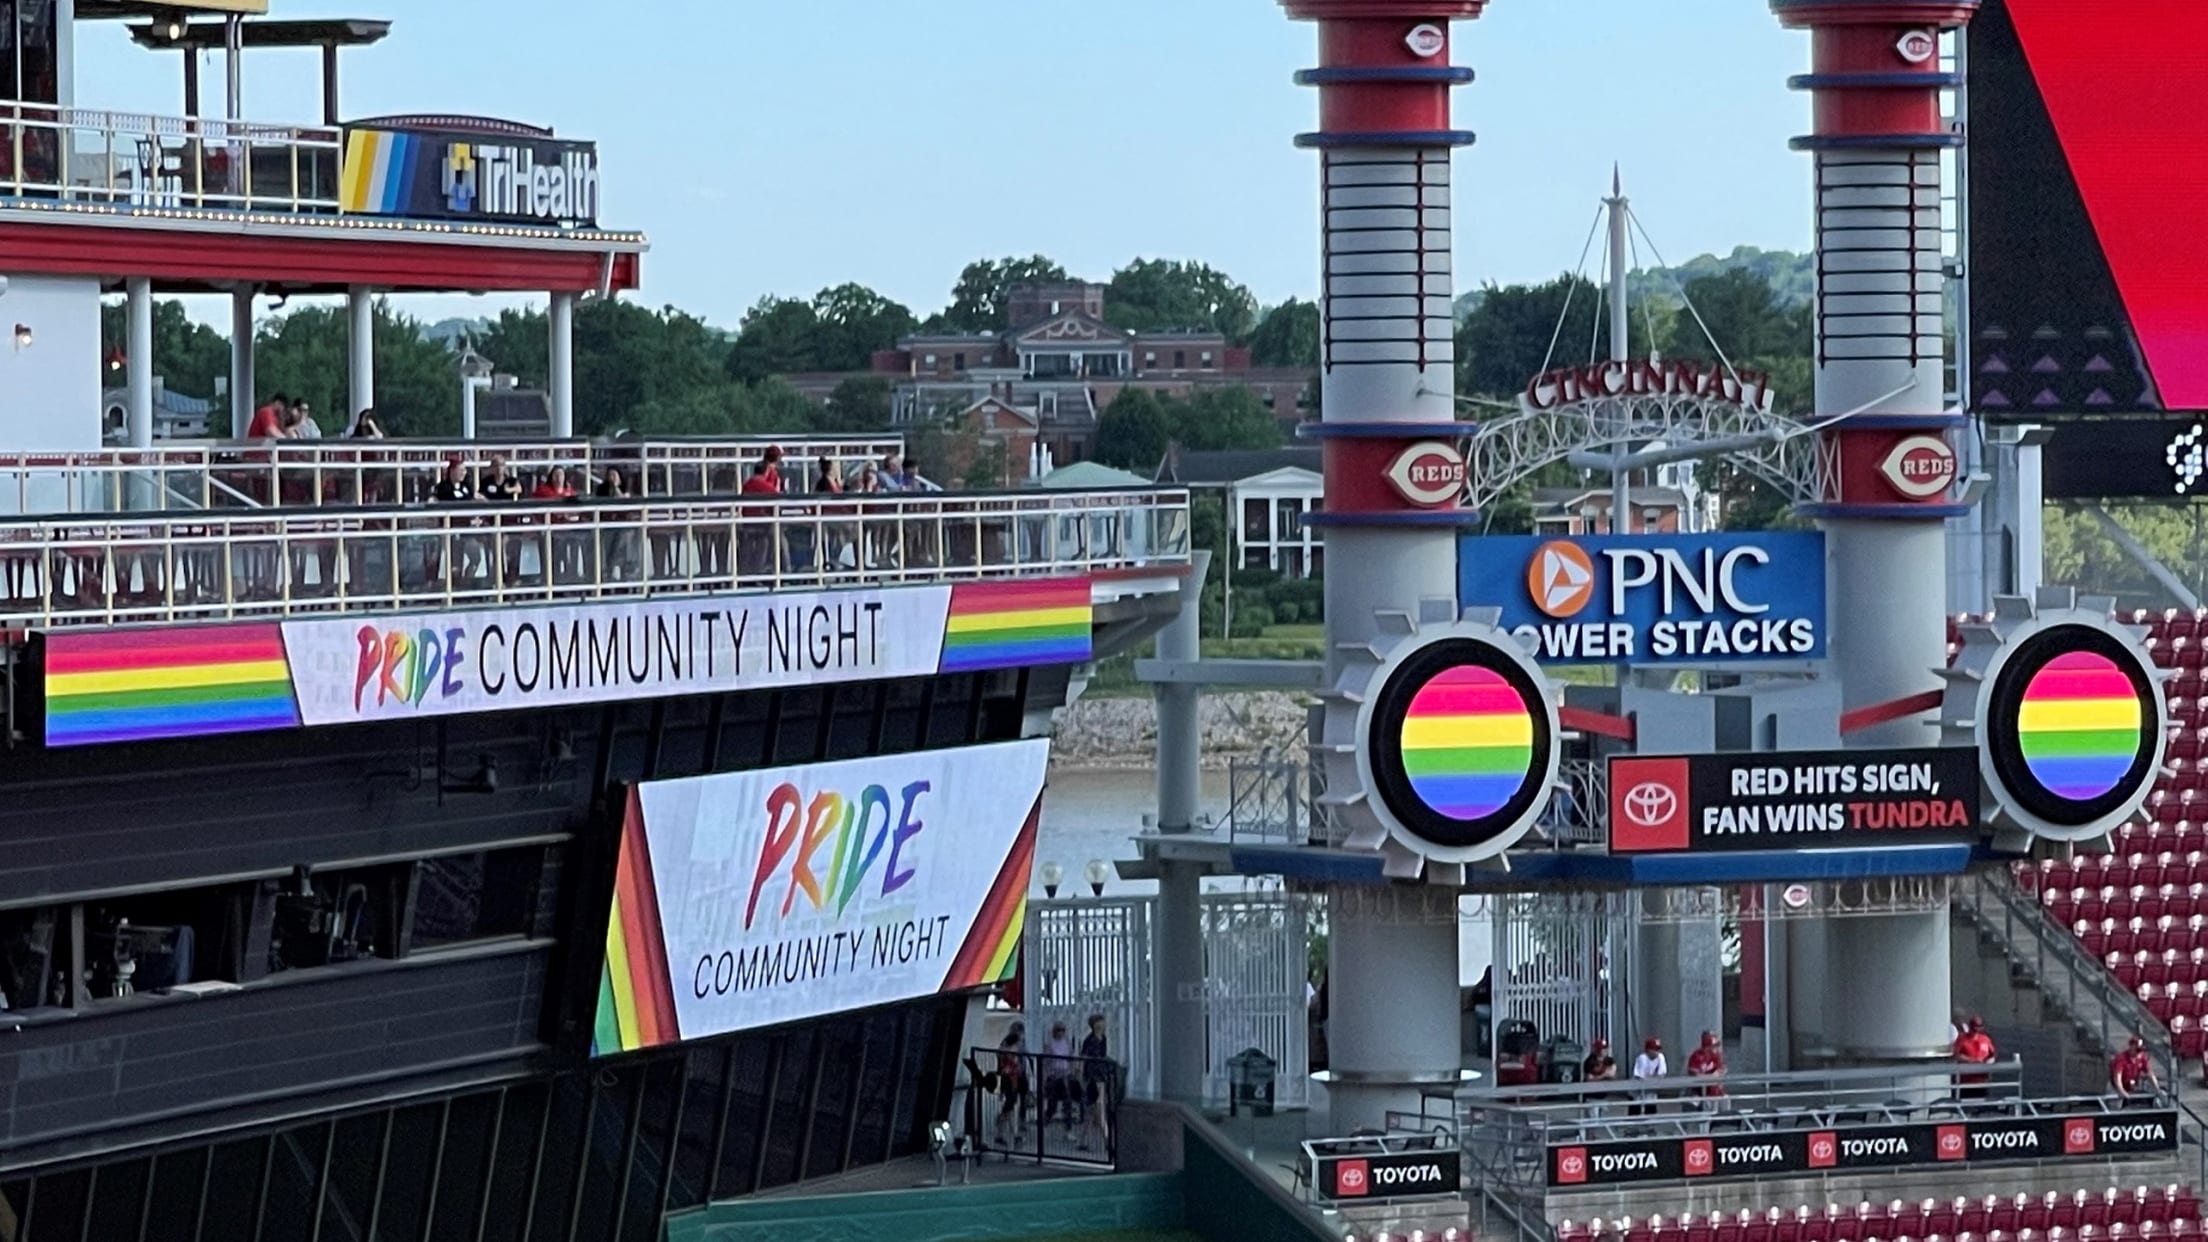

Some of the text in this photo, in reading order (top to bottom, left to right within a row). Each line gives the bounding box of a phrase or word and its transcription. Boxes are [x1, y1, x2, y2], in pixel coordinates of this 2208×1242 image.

[477, 144, 600, 219] TriHealth
[1527, 359, 1768, 410] CINCINNATI
[1412, 464, 1464, 482] REDS
[1903, 458, 1954, 475] REDS
[1602, 546, 1770, 615] PNC
[1496, 618, 1815, 657] OWER STACKS
[354, 602, 882, 712] PRIDE COMMUNITY NIGHT
[1732, 763, 1940, 796] RED HITS SIGN,
[1704, 799, 1968, 834] FAN WINS TUNDRA
[745, 780, 931, 931] PRIDE
[694, 915, 950, 999] COMMUNITY NIGHT
[1842, 1138, 1908, 1156] TOYOTA
[1971, 1131, 2038, 1149] TOYOTA
[2099, 1124, 2165, 1142] TOYOTA
[1592, 1152, 1658, 1171] TOYOTA
[1718, 1145, 1783, 1164] TOYOTA
[1373, 1164, 1442, 1184] TOYOTA
